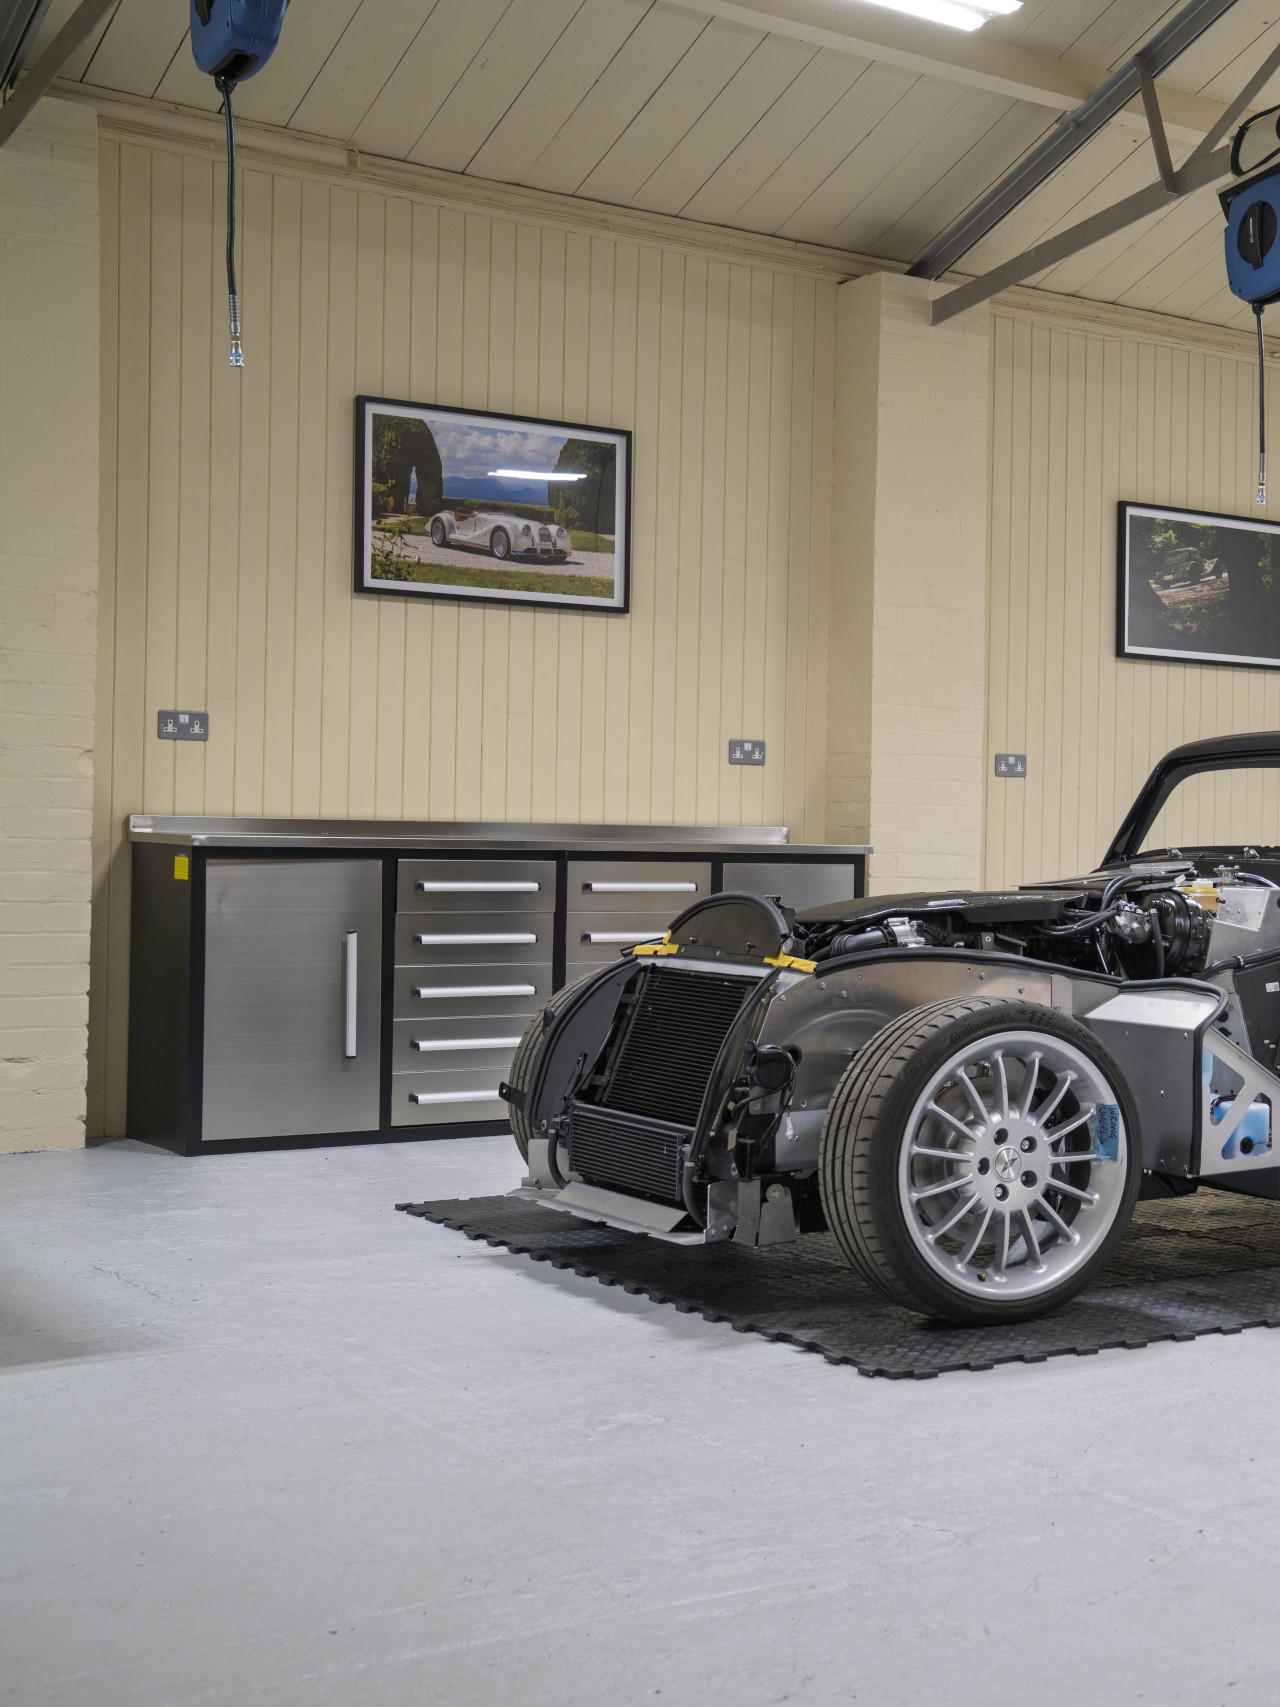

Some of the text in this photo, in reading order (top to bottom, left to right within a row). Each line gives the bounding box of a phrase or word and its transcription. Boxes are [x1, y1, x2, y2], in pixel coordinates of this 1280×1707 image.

[949, 1014, 1006, 1044] Continental
[1099, 1106, 1107, 1144] WHEELS
[1109, 1107, 1118, 1139] WRONG
